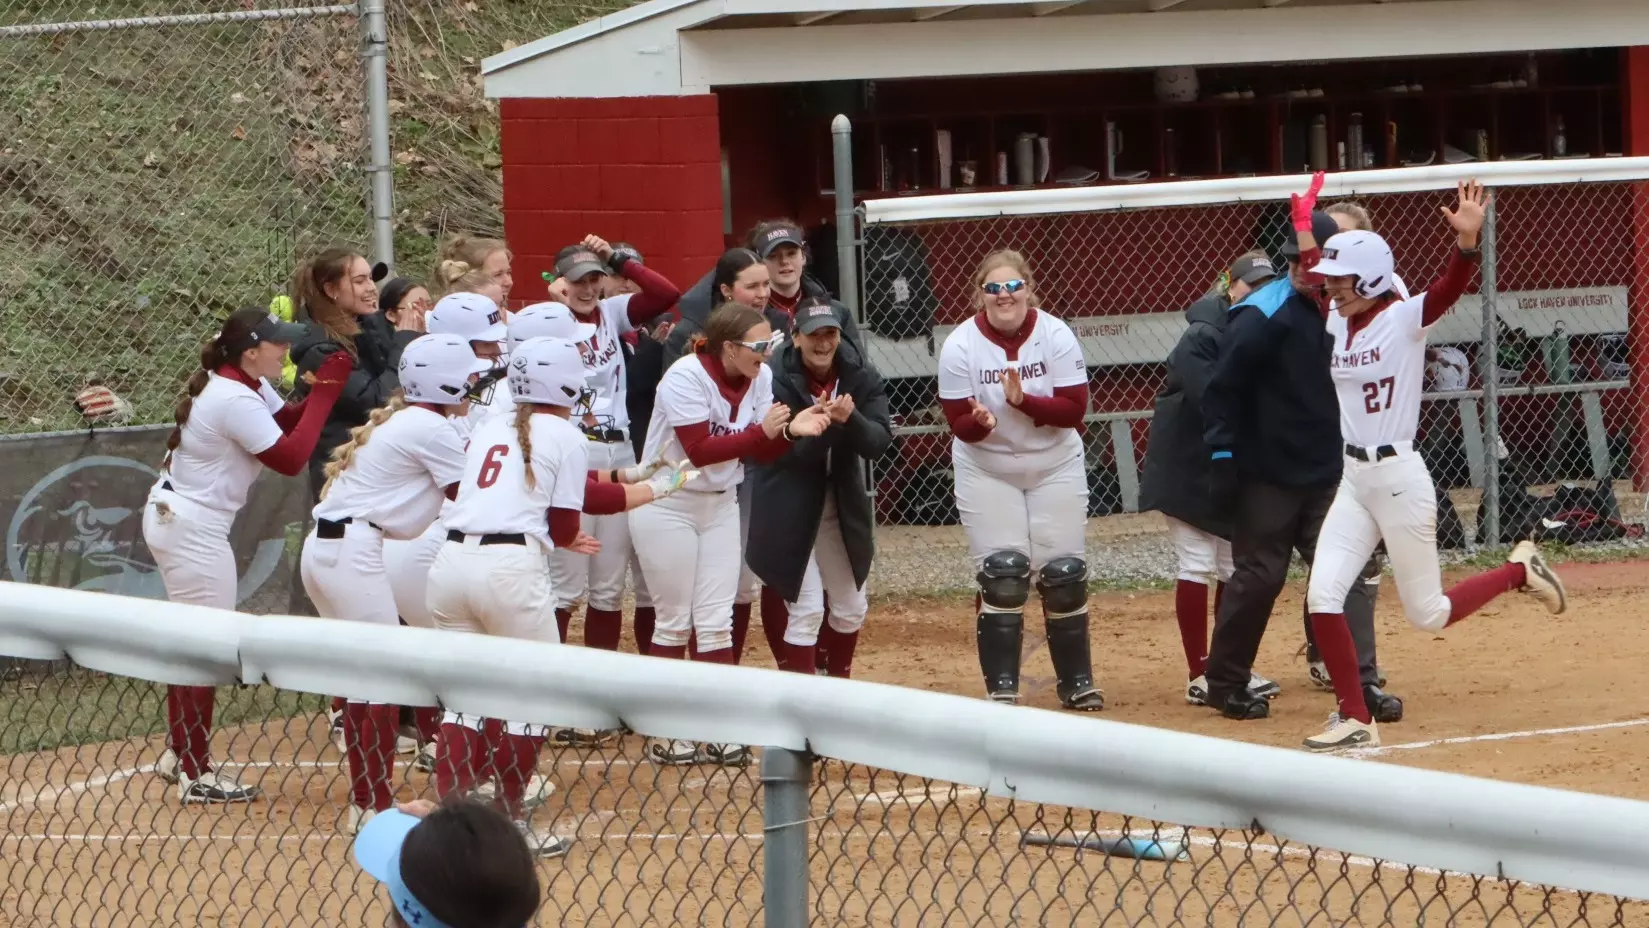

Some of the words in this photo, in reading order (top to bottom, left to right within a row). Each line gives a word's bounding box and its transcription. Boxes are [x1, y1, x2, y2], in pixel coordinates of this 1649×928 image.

[1518, 297, 1538, 310] LOCK
[1540, 296, 1566, 308] HAVEN
[1568, 294, 1613, 307] UNIVERSITY
[1080, 324, 1129, 337] UNIVERSITY
[1342, 347, 1380, 369] HAVEN
[1362, 375, 1395, 414] 27
[477, 444, 509, 489] 6
